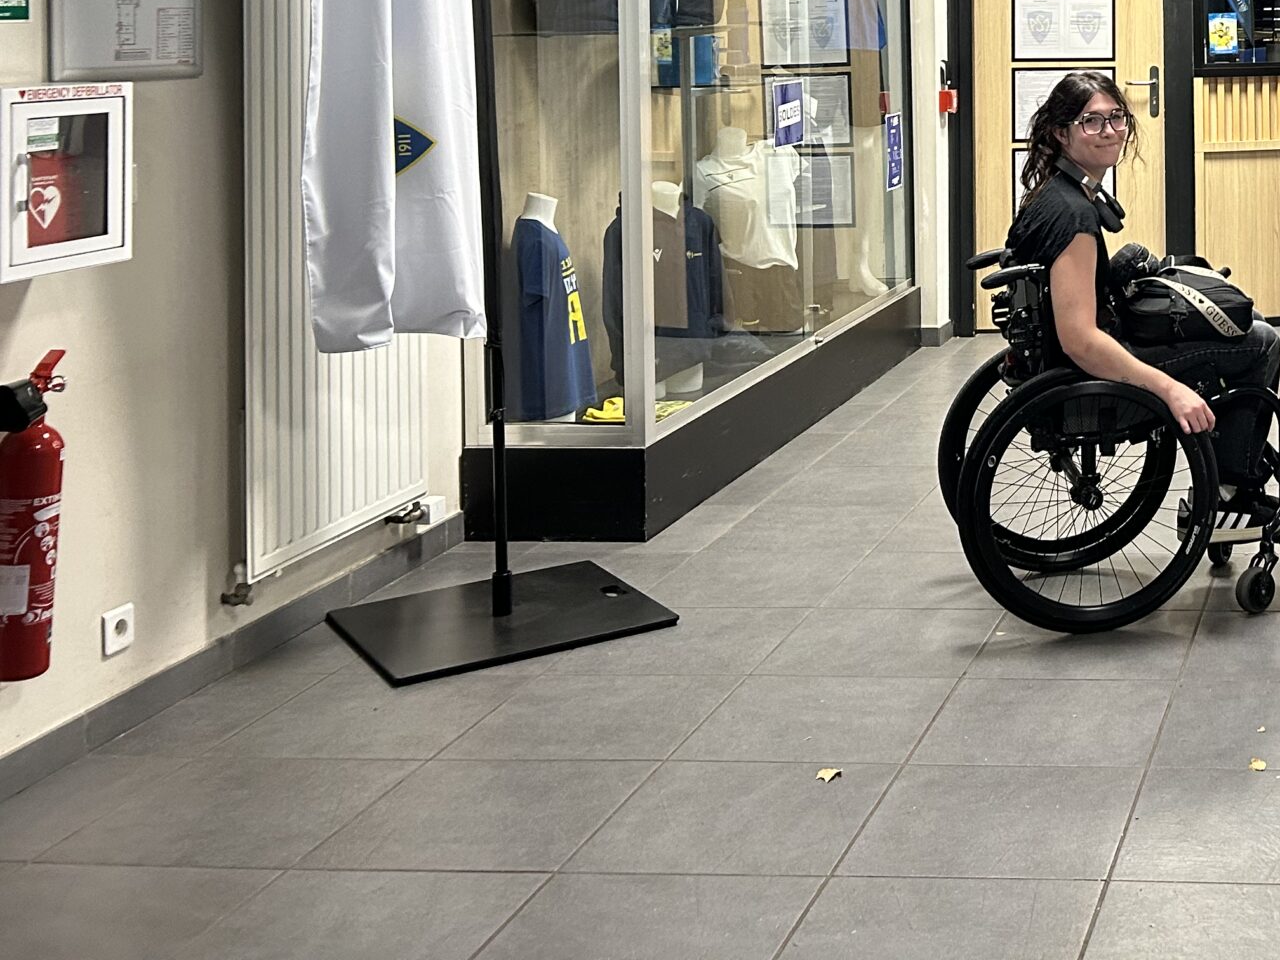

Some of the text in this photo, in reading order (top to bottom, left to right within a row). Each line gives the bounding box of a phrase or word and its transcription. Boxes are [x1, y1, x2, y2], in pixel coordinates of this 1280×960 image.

[27, 84, 123, 101] EMERGENCY DEFIBRILLATOR
[779, 105, 800, 123] SOLDES
[397, 134, 412, 156] 1911
[1205, 305, 1238, 336] GUESS
